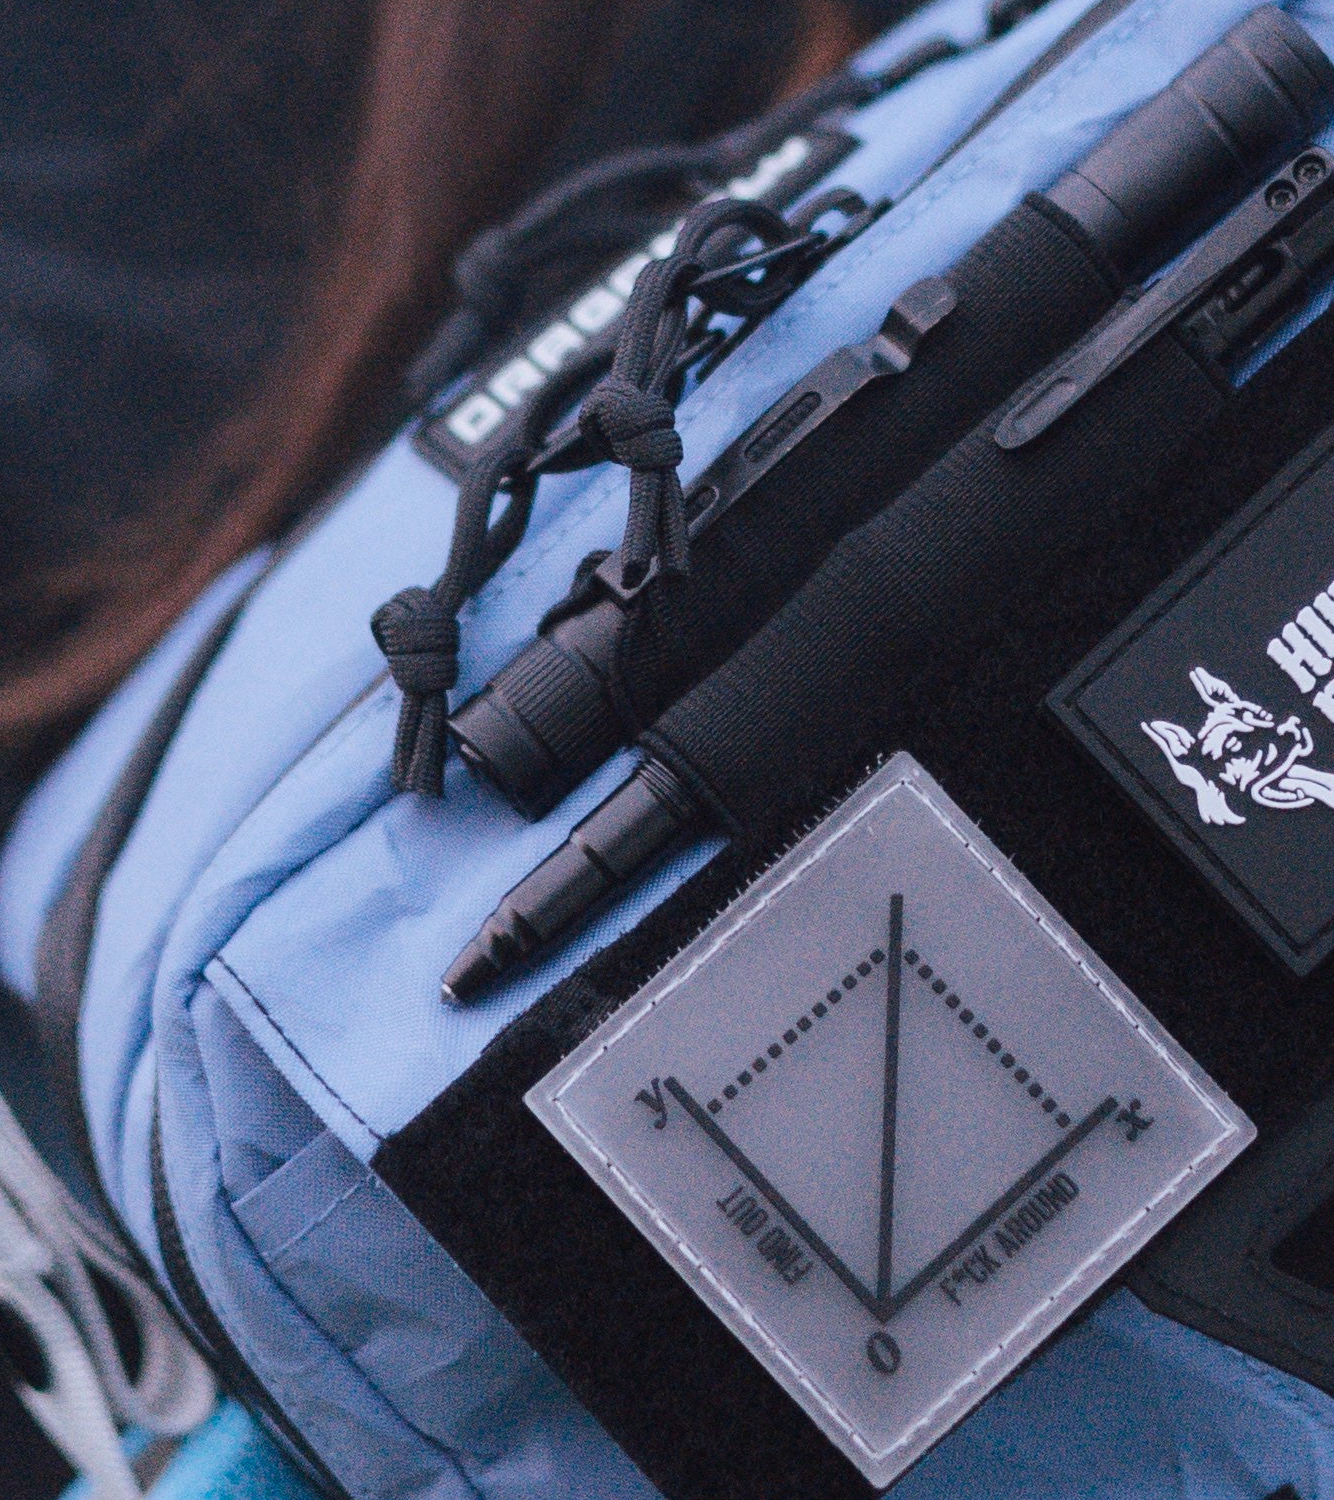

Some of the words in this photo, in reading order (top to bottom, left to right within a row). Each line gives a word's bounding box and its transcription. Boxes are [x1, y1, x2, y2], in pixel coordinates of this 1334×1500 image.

[715, 1186, 769, 1236] OUT
[994, 1172, 1079, 1258] AROUND
[757, 1226, 814, 1287] FIND
